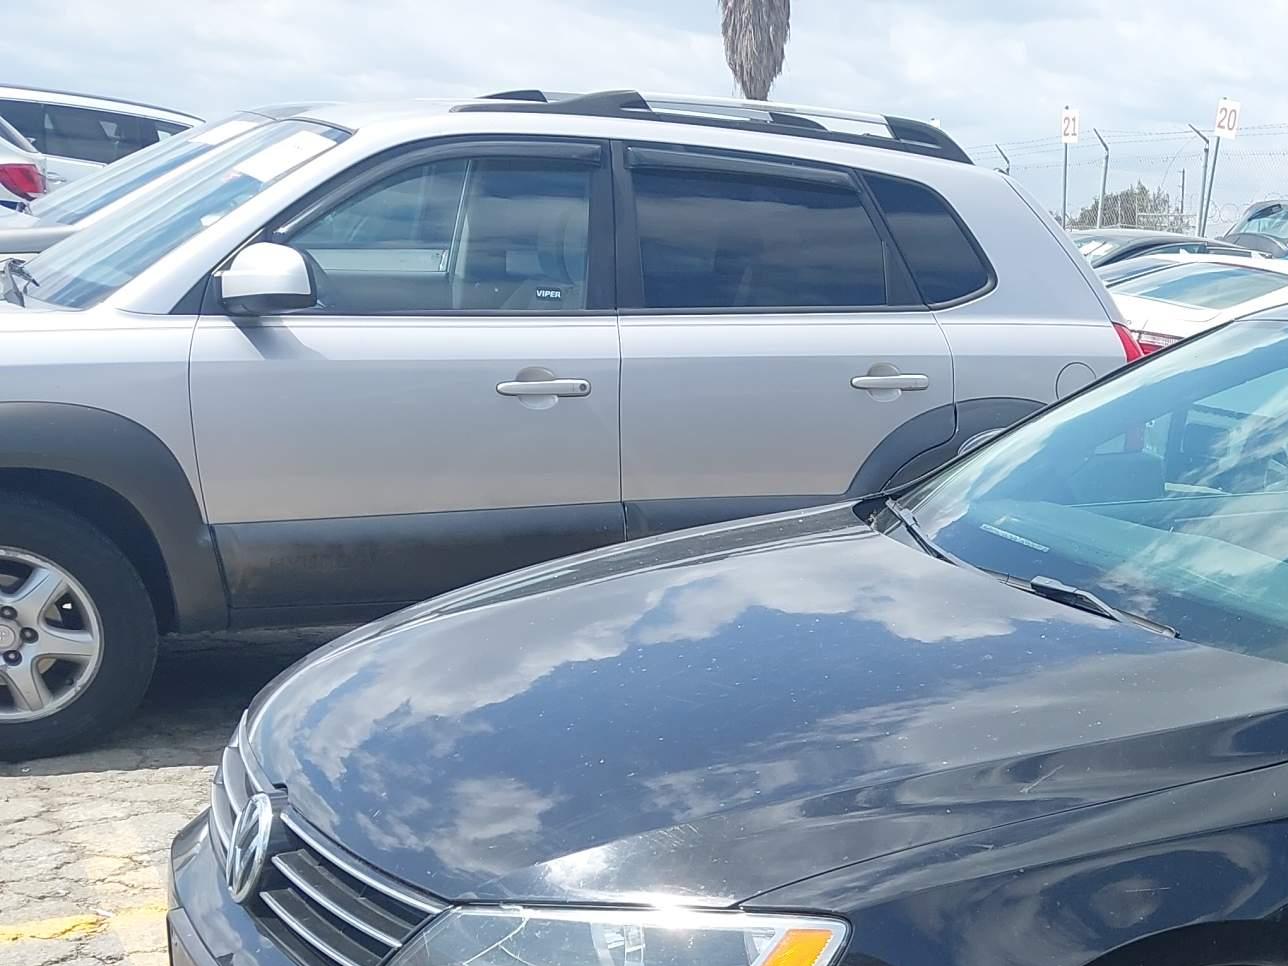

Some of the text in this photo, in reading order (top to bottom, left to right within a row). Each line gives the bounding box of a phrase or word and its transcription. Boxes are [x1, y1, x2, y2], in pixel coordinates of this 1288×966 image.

[1063, 116, 1078, 137] 21
[1217, 107, 1237, 131] 20
[536, 289, 561, 298] VIPER
